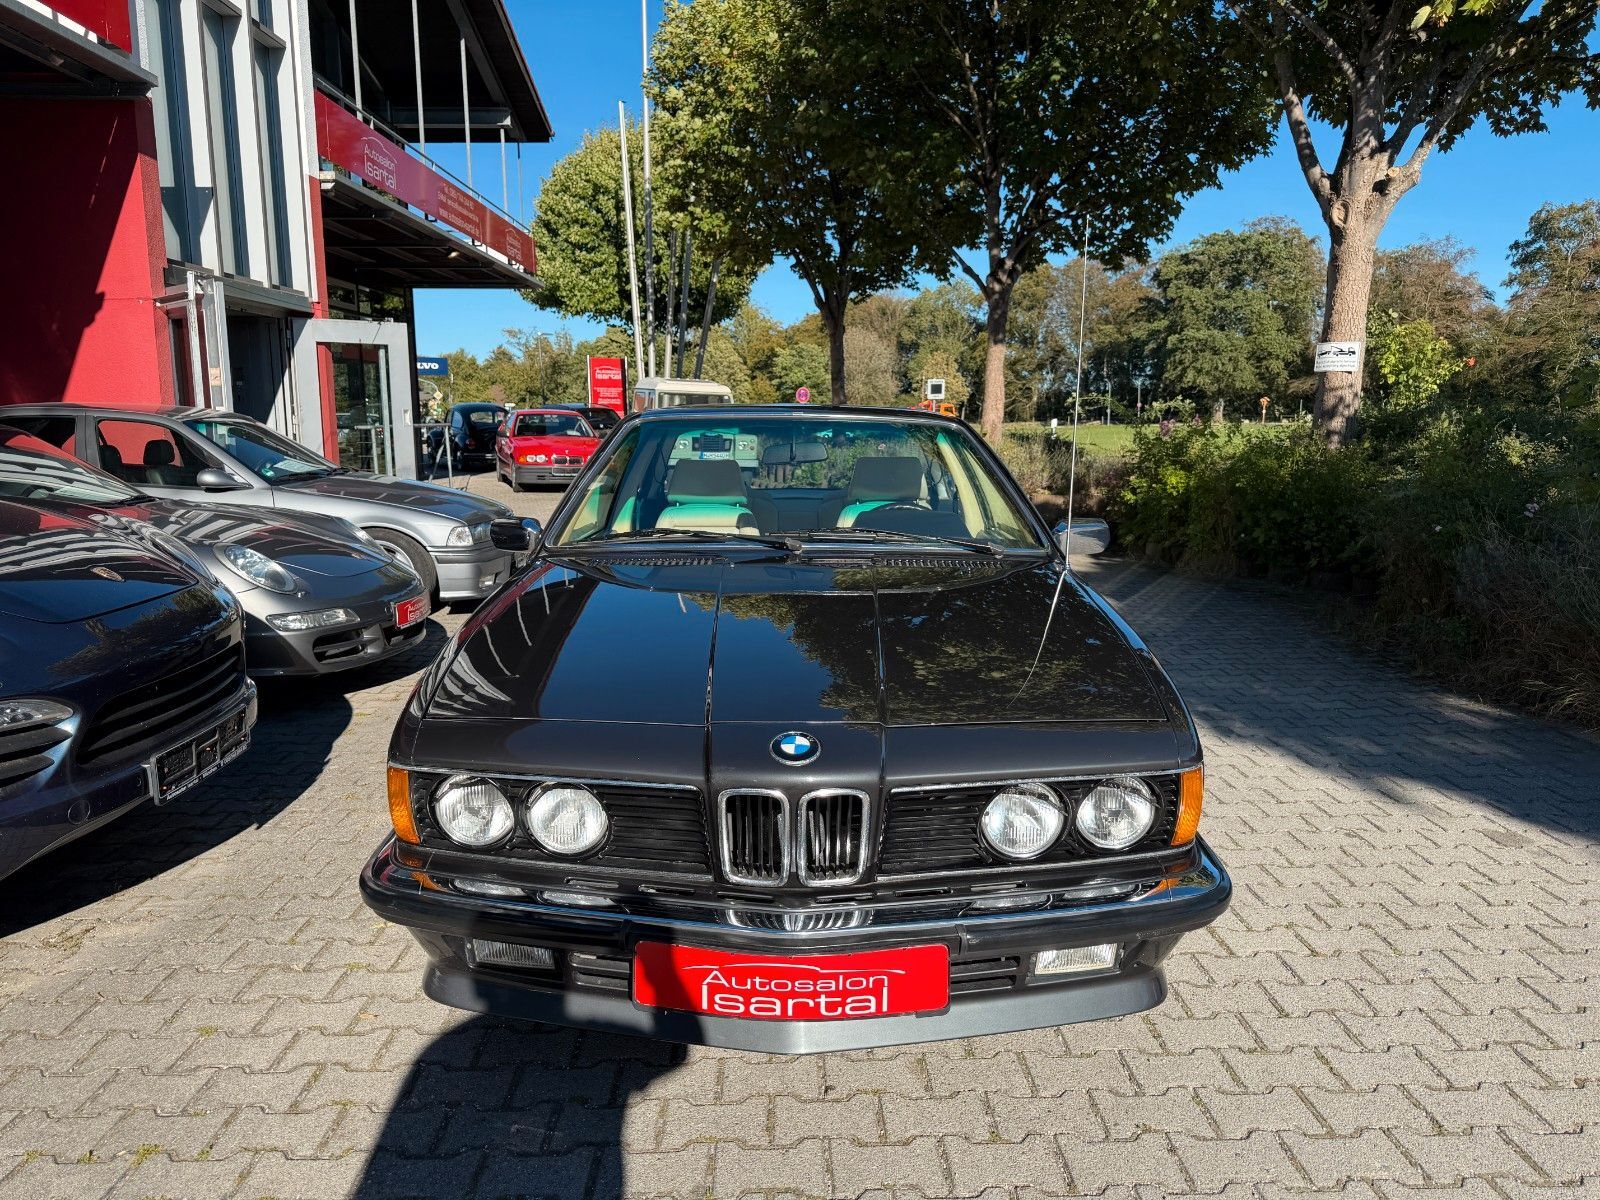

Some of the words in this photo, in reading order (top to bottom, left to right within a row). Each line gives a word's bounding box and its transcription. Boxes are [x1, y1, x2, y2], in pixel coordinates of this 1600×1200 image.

[364, 144, 395, 170] Autosalon
[364, 155, 397, 190] Isartal
[702, 970, 889, 993] Autosalon
[702, 985, 889, 1017] Isartal
